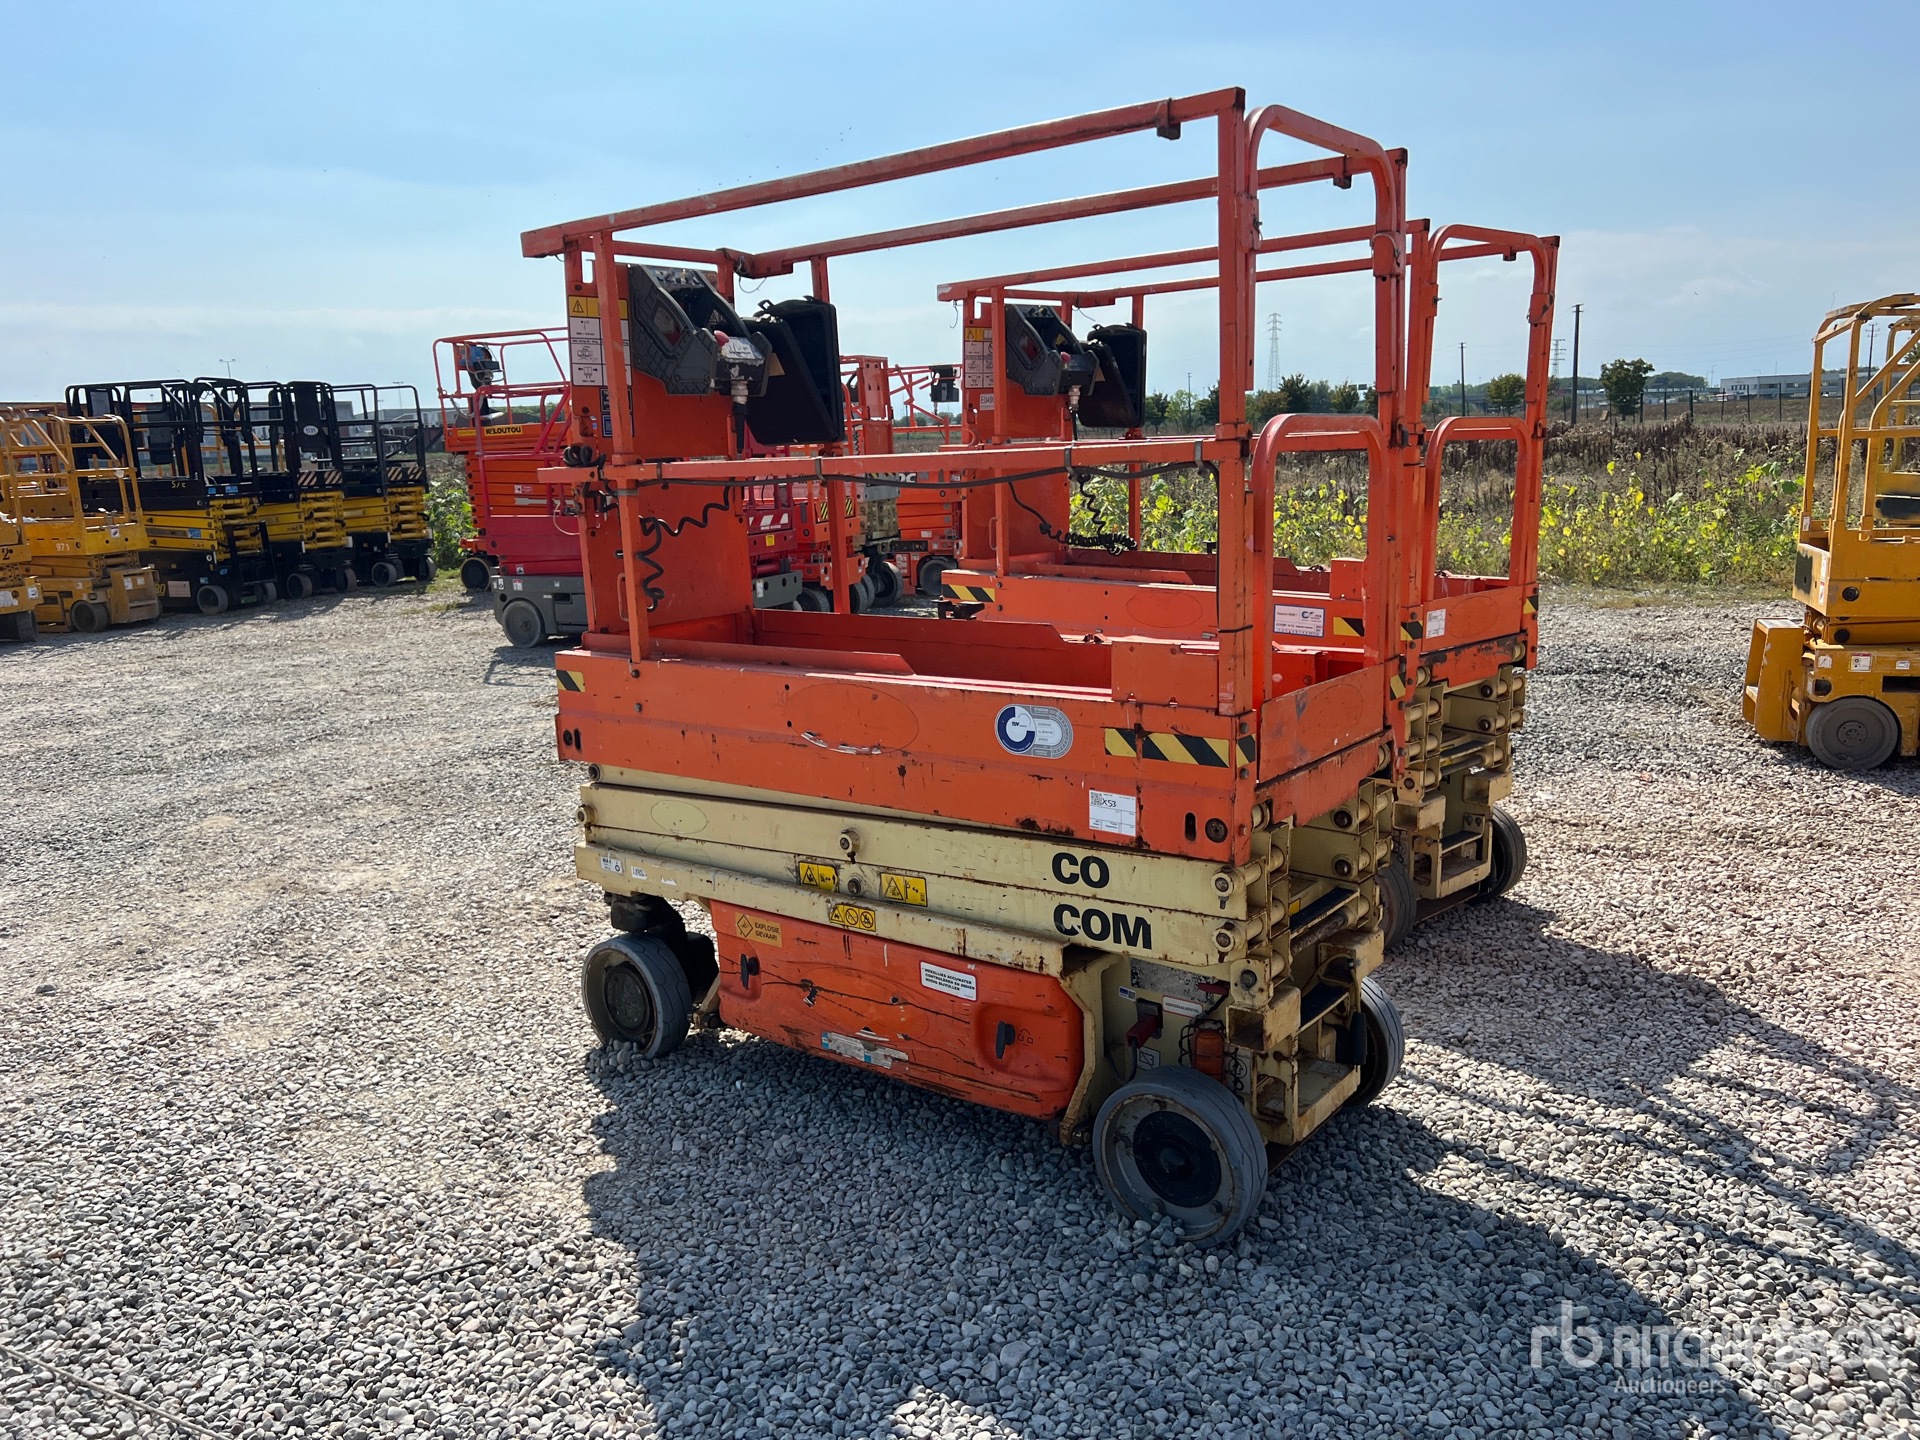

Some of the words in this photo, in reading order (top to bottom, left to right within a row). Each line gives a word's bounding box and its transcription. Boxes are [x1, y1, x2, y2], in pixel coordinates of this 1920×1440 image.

[1052, 852, 1110, 889] CO
[755, 922, 779, 934] EXPLOSIE
[1053, 903, 1153, 950] COM
